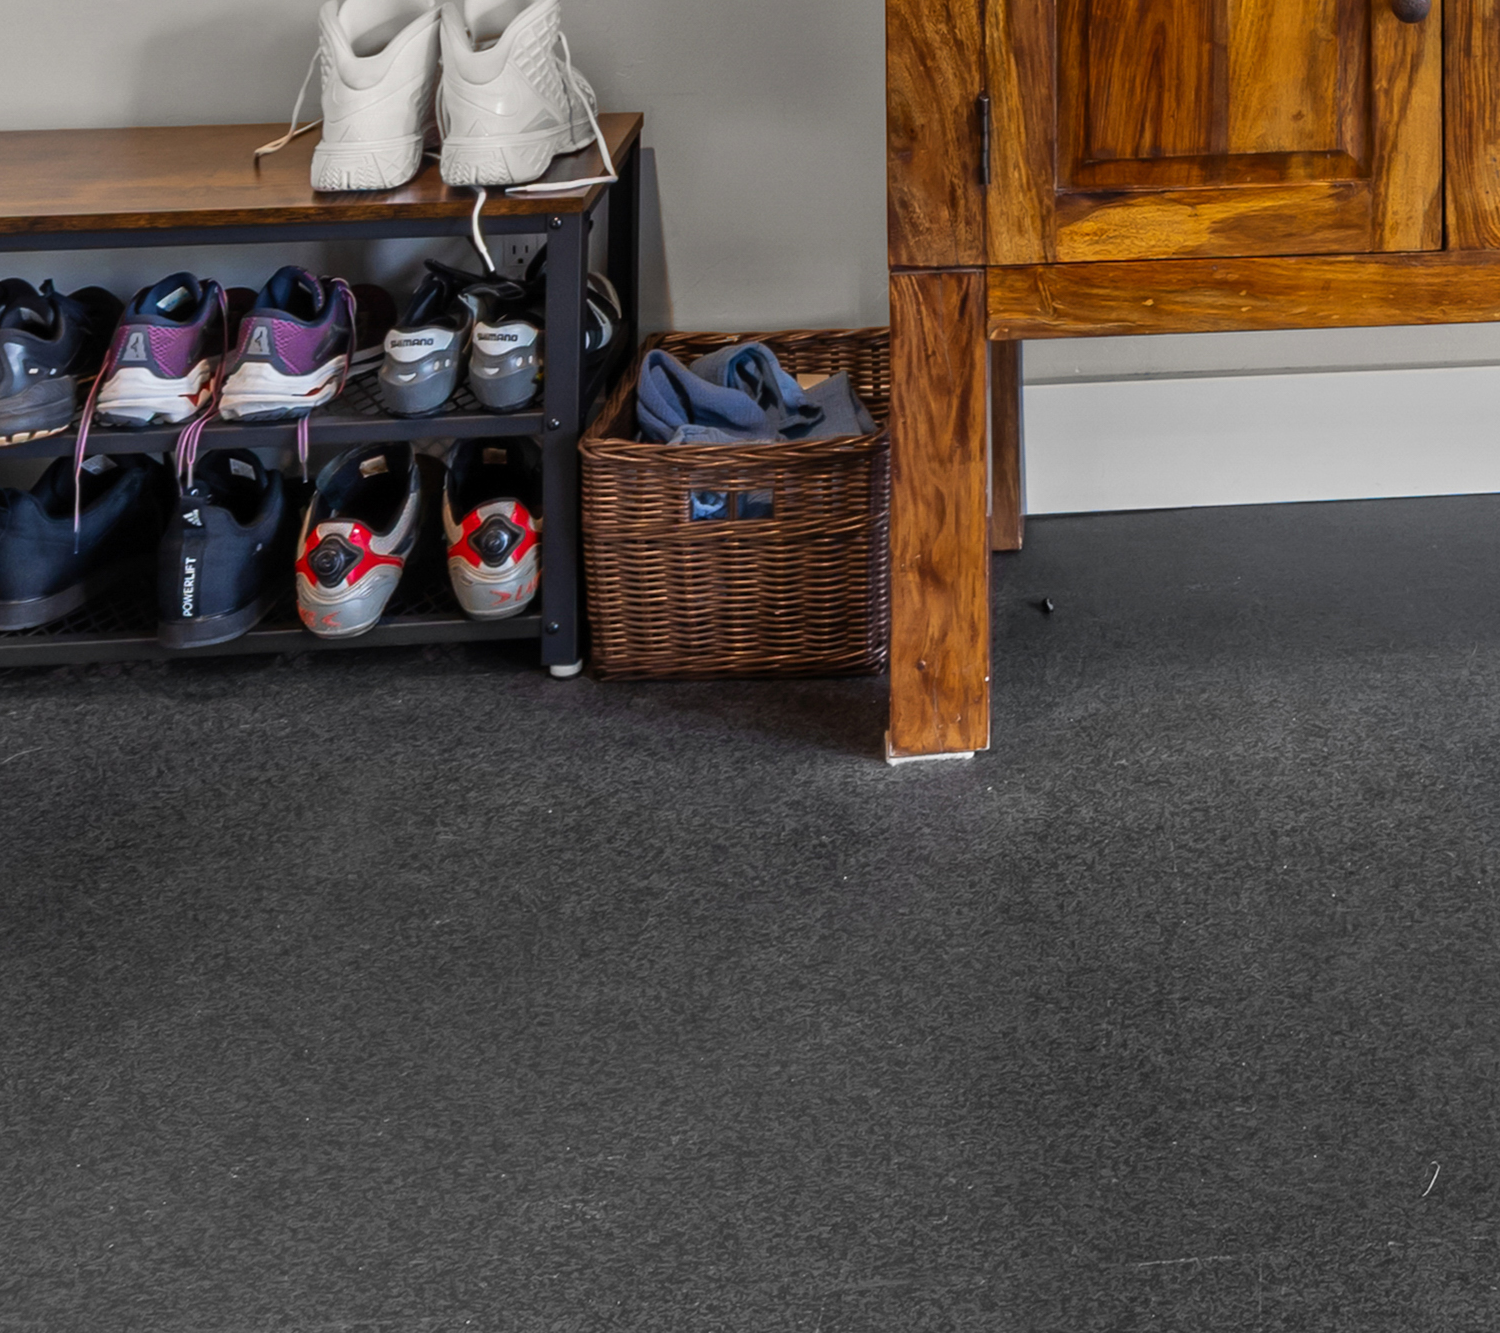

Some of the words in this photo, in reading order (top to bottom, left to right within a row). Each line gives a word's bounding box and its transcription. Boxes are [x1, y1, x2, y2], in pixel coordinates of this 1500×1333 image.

[477, 332, 519, 342] SHIMANO
[390, 338, 434, 349] SHIMANO
[182, 556, 197, 618] POWERLIFT
